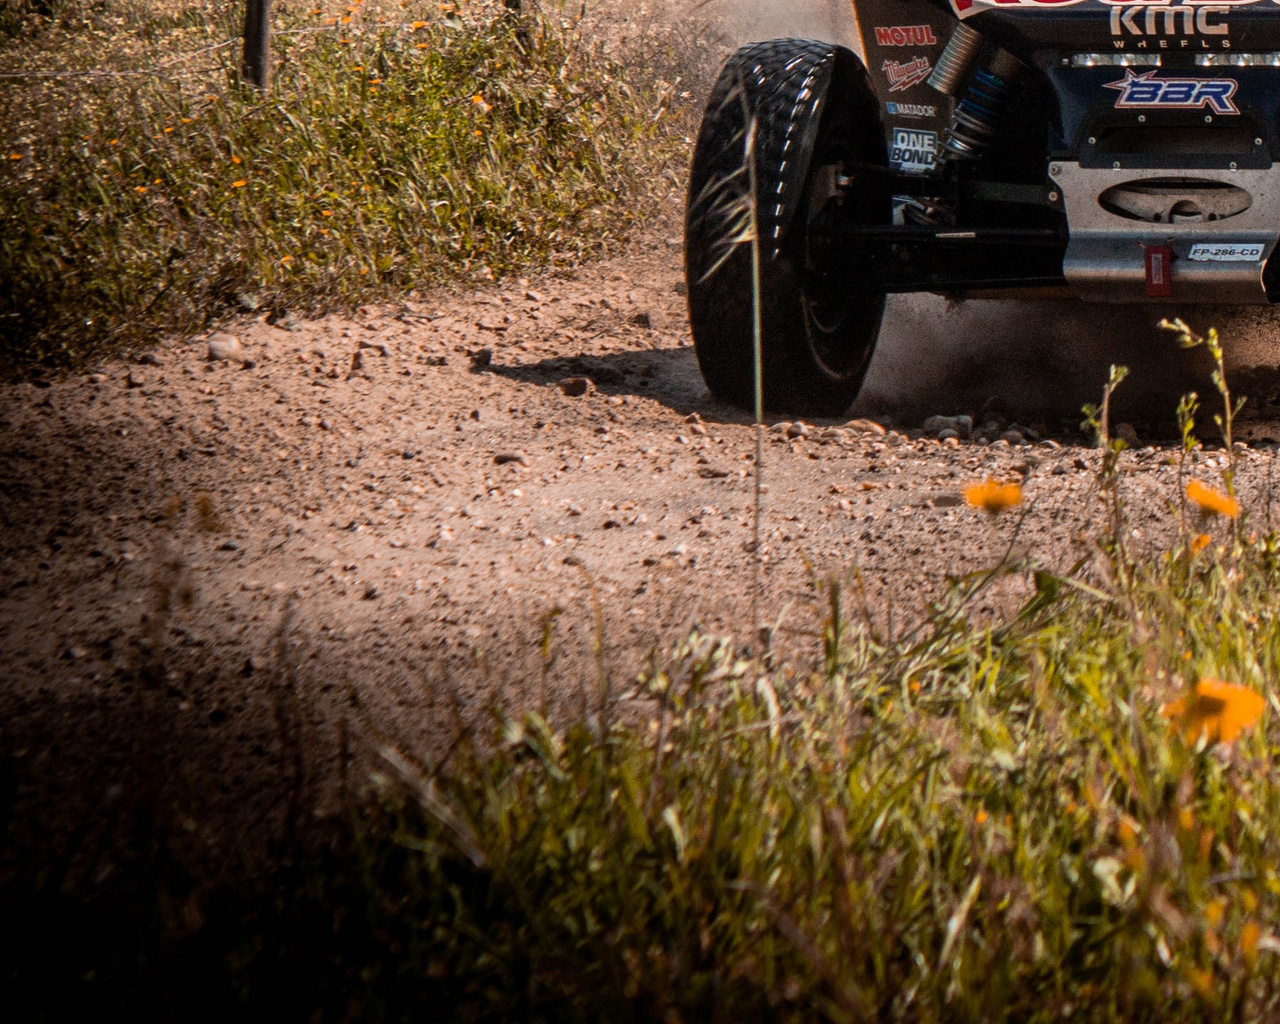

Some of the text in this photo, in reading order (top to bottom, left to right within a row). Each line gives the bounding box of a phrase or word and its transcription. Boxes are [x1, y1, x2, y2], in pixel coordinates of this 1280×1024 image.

[875, 25, 937, 46] MOTUL
[1124, 79, 1234, 111] BBR
[897, 104, 935, 117] MATADOR
[897, 132, 934, 151] ONE
[890, 148, 934, 165] BOND
[1193, 248, 1260, 257] FP-286-CD
